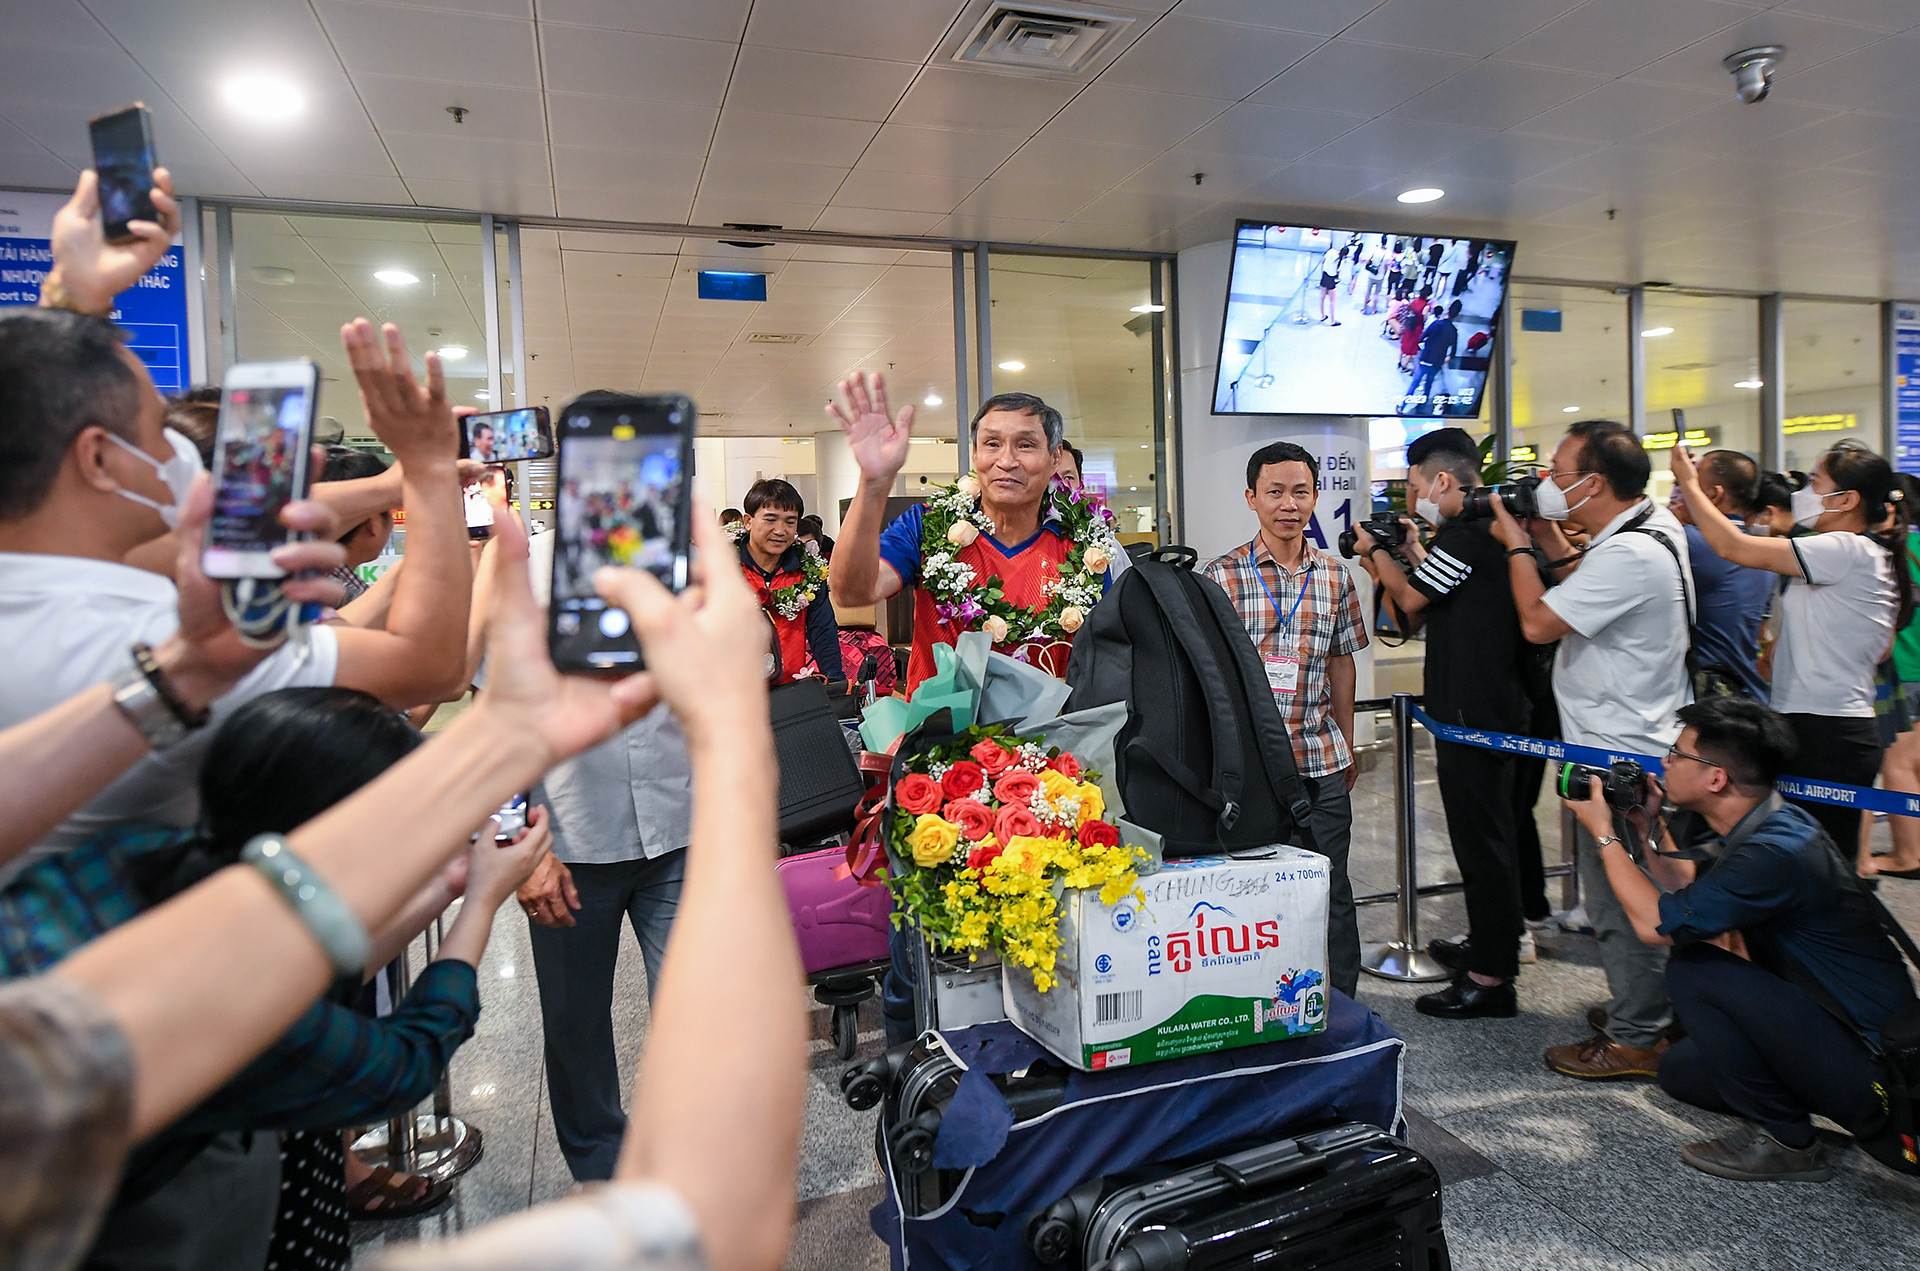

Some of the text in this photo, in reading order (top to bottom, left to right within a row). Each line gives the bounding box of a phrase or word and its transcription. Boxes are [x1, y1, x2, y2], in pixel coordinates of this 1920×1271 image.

[22, 290, 37, 302] to
[1327, 451, 1356, 471] ĐẾN
[1332, 476, 1356, 491] Hall
[1518, 738, 1530, 752] TẾ
[1548, 743, 1565, 758] BÀI
[1805, 785, 1857, 803] AIRPORT
[1275, 868, 1326, 883] 24 x 700ml
[1147, 934, 1161, 977] eau
[1157, 1014, 1250, 1035] KULARA WATER CO., LTD.
